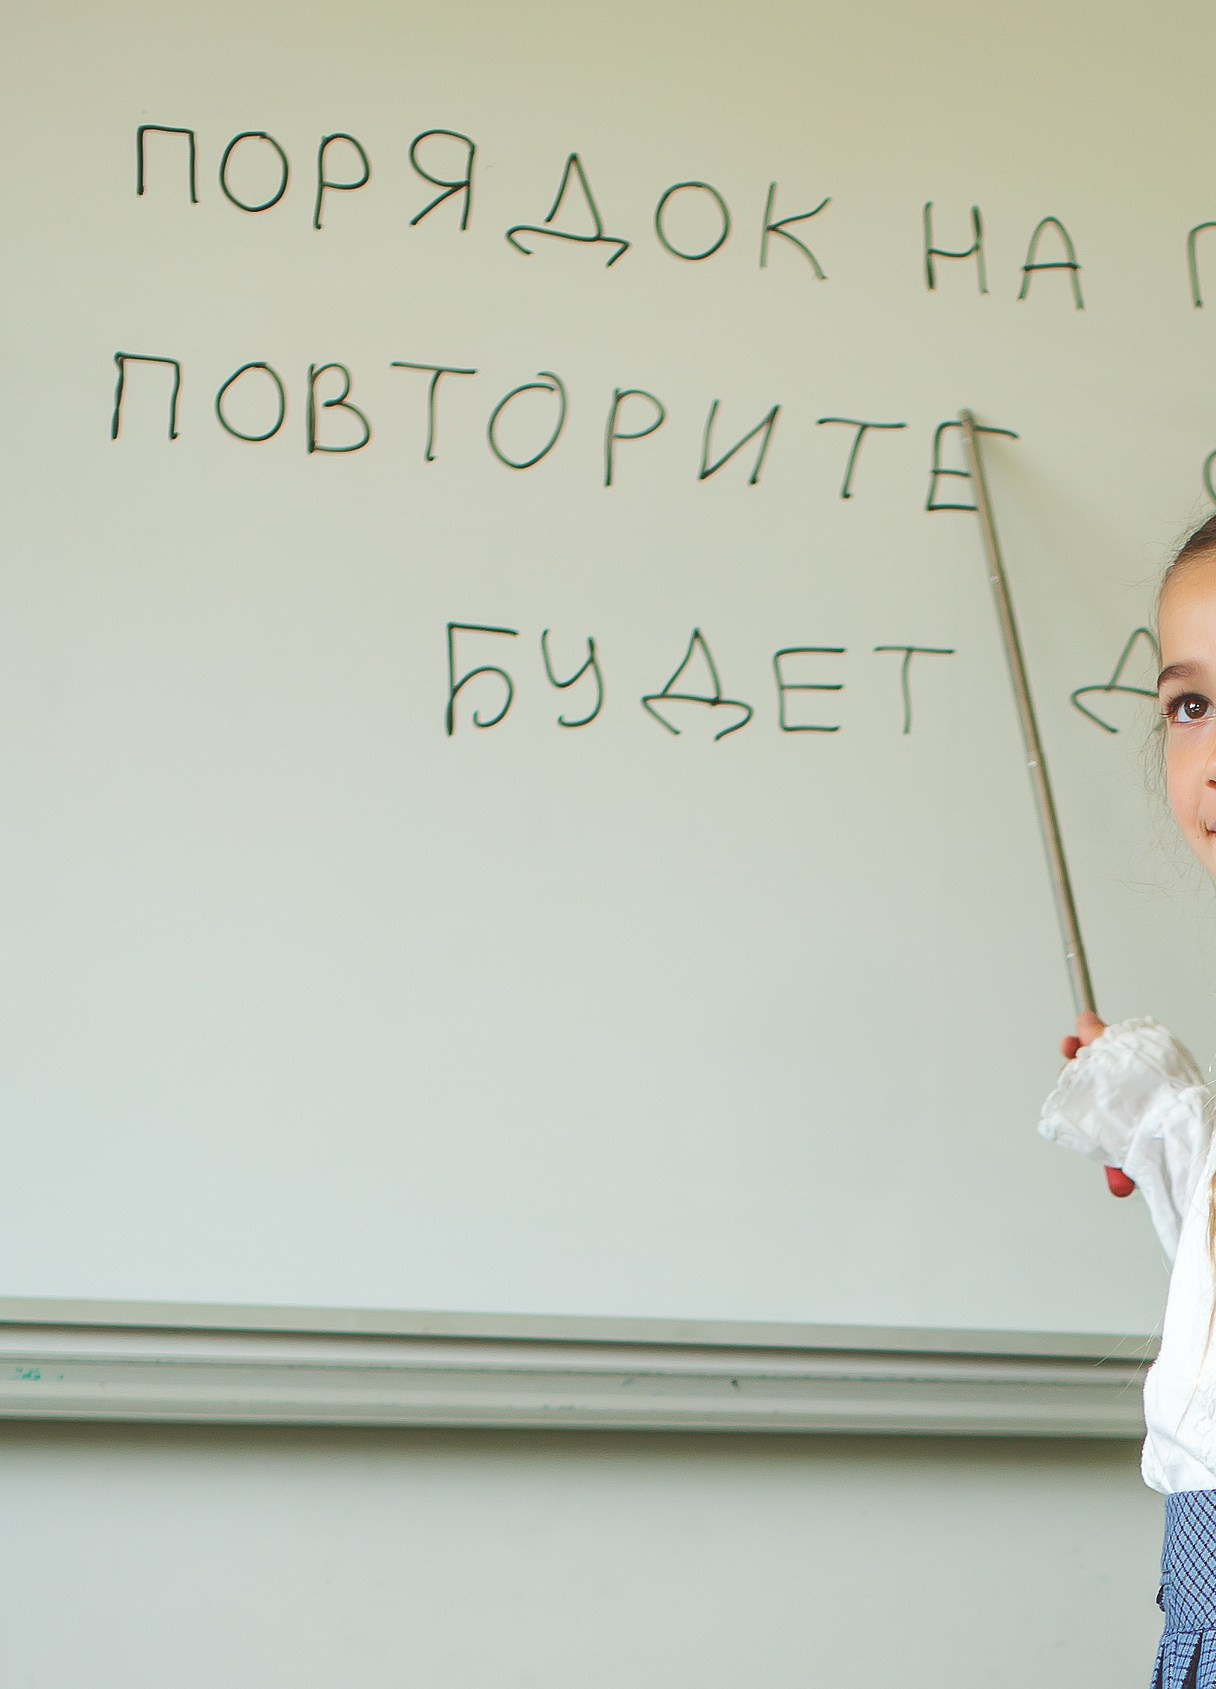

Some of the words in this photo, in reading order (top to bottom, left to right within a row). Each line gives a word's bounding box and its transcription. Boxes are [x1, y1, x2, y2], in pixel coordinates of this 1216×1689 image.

[136, 124, 832, 281] ПОРЯДОК
[922, 200, 1086, 311] НА
[111, 350, 1020, 512] ПОВТОРИТЕ
[445, 620, 957, 742] БУДЕТ
